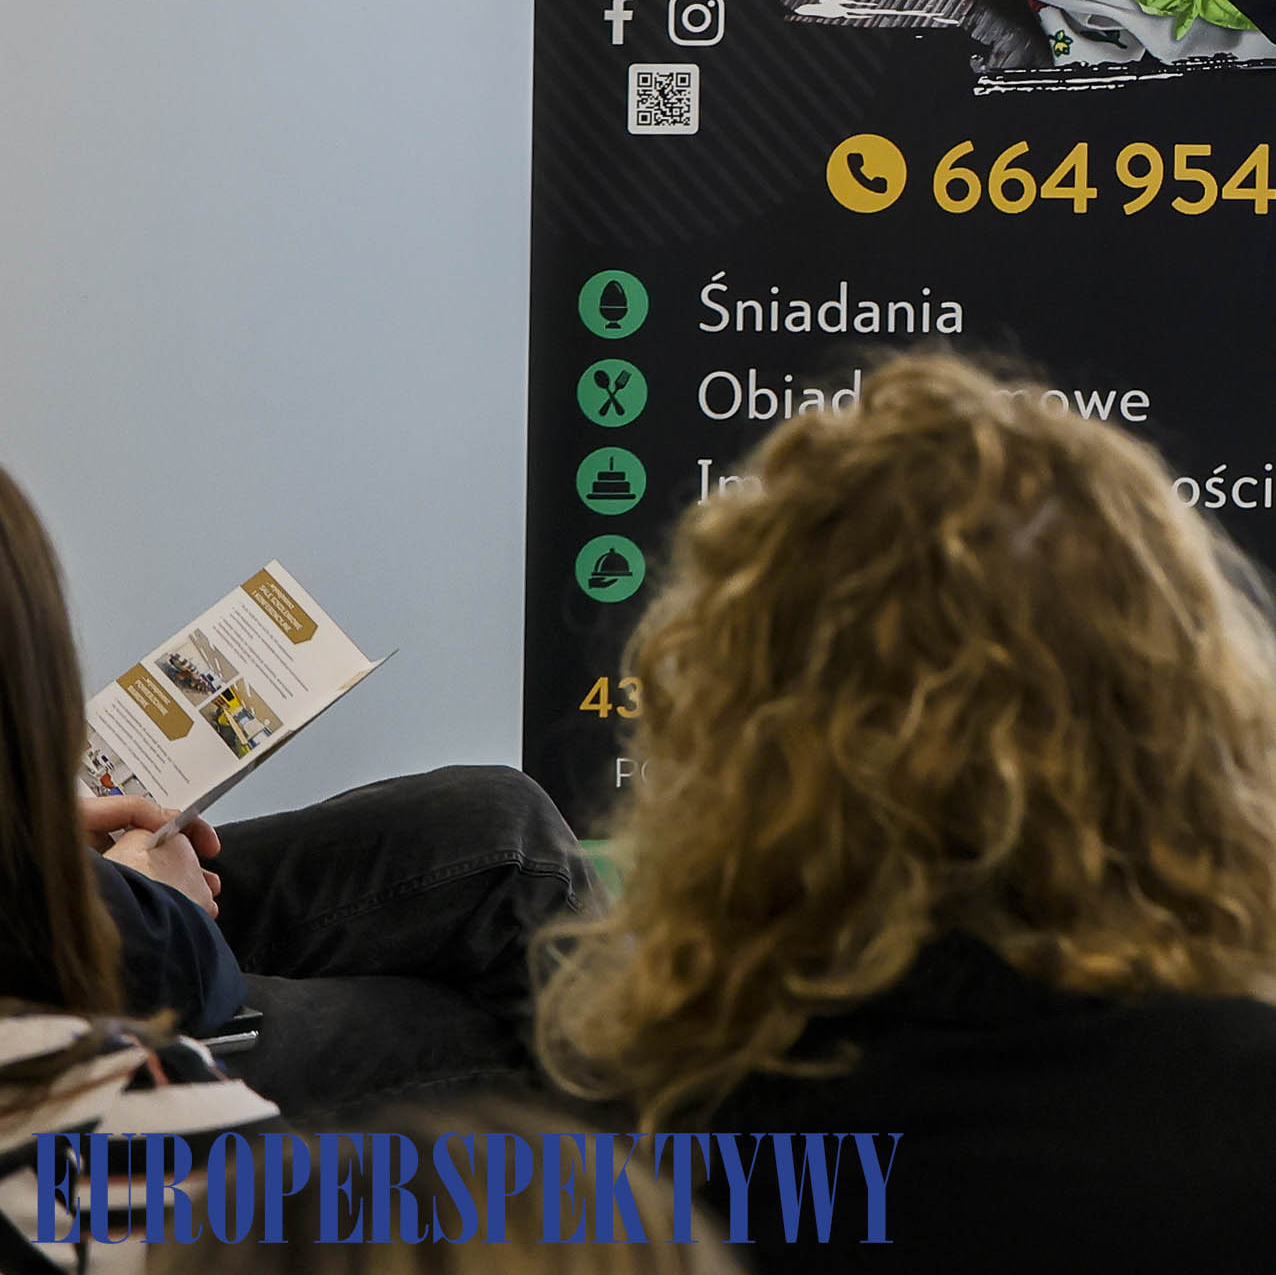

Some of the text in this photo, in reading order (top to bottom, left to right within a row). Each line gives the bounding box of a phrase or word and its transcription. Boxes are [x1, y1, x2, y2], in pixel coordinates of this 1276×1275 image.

[934, 141, 1097, 213] 664
[700, 272, 962, 333] Śniadania
[698, 368, 863, 421] Obiad
